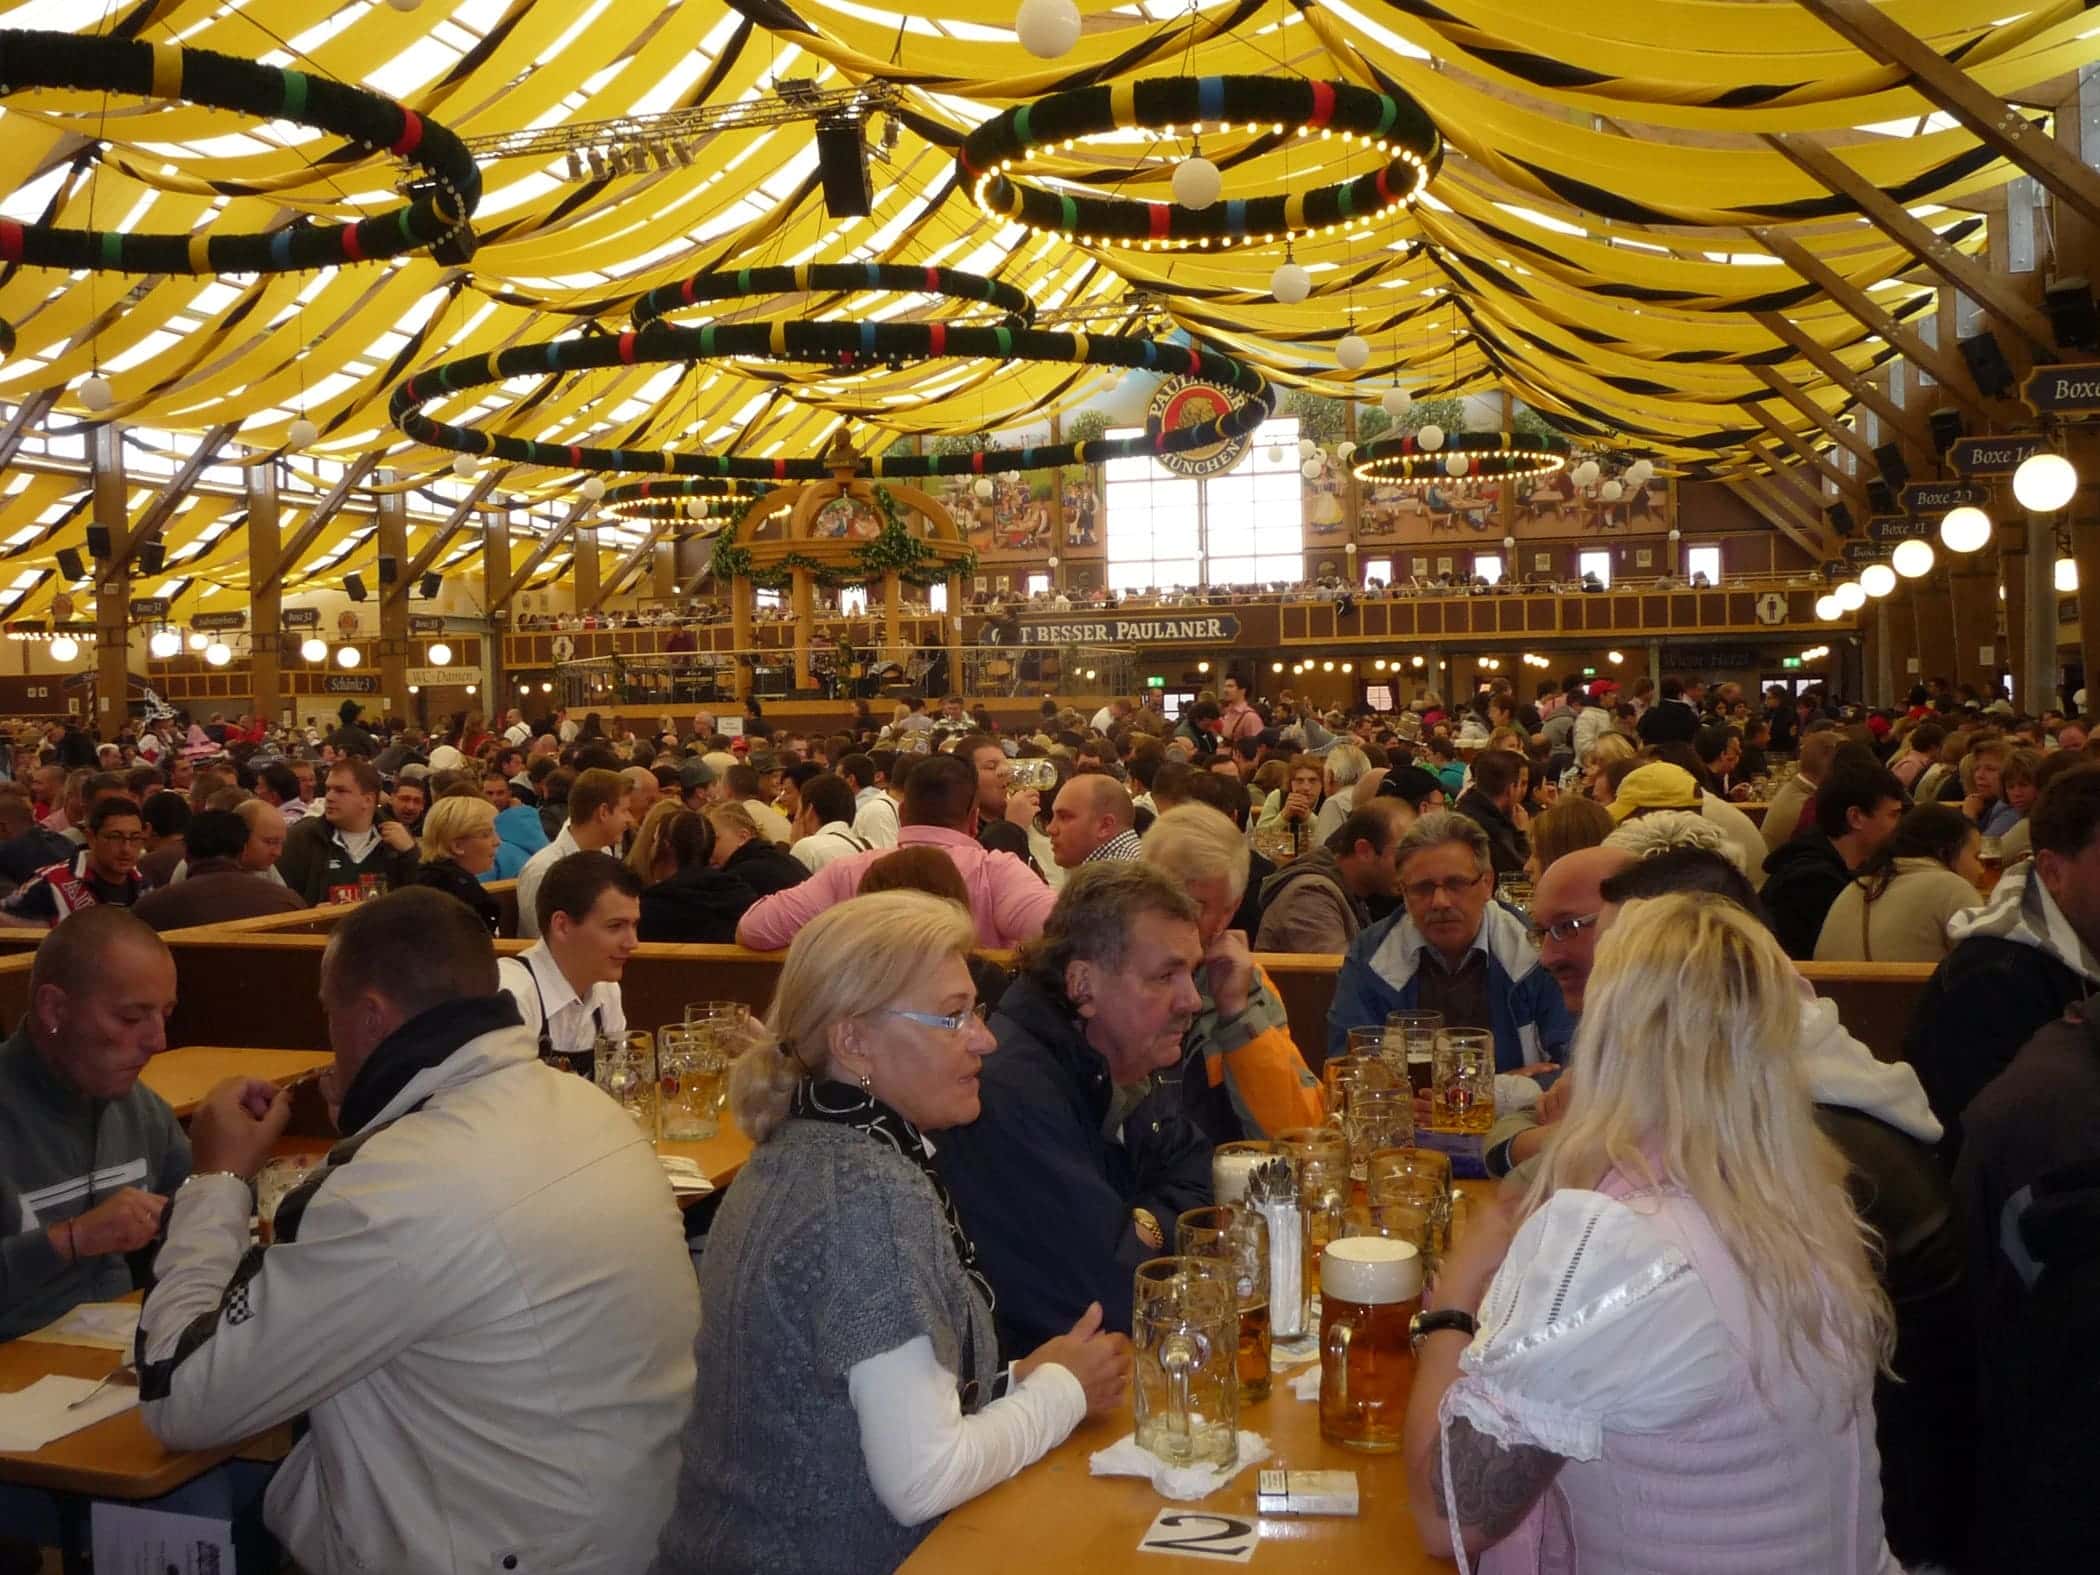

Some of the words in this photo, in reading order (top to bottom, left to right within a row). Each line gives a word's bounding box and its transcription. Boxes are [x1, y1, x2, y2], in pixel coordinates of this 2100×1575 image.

[1971, 448, 2011, 465] Boxe
[1917, 491, 1950, 505] Boxe
[1116, 618, 1227, 640] PAULANER.
[1144, 1515, 1252, 1556] 2
